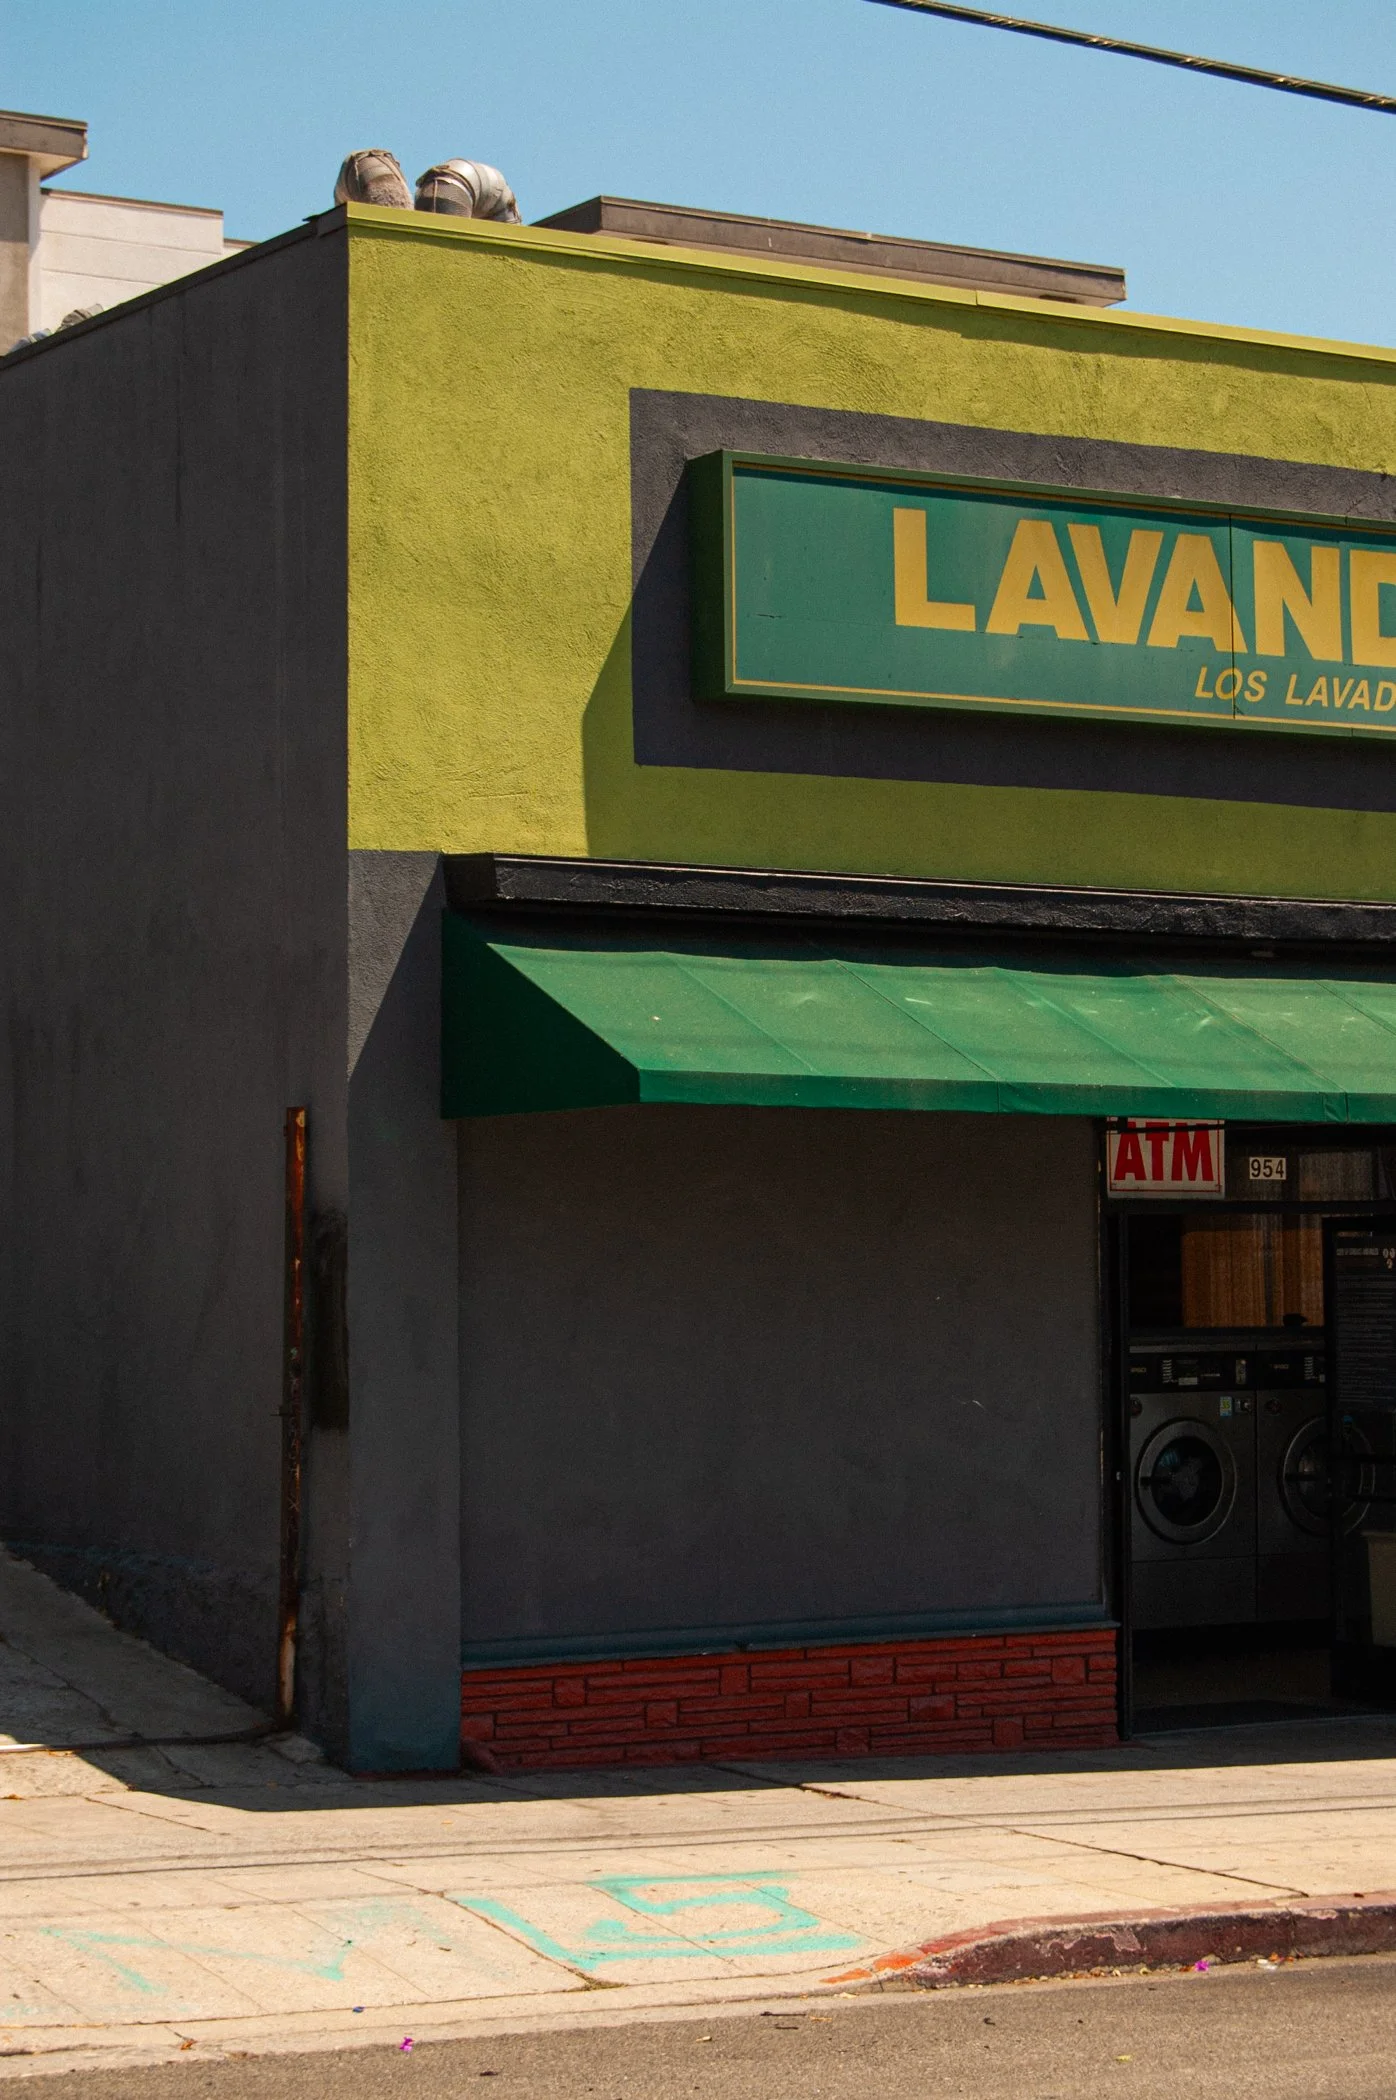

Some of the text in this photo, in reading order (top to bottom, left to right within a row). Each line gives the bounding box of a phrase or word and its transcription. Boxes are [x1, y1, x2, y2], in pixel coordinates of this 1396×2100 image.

[1194, 665, 1396, 712] LOS LAVAD
[1113, 1120, 1215, 1182] ATM
[1250, 1158, 1285, 1179] 954
